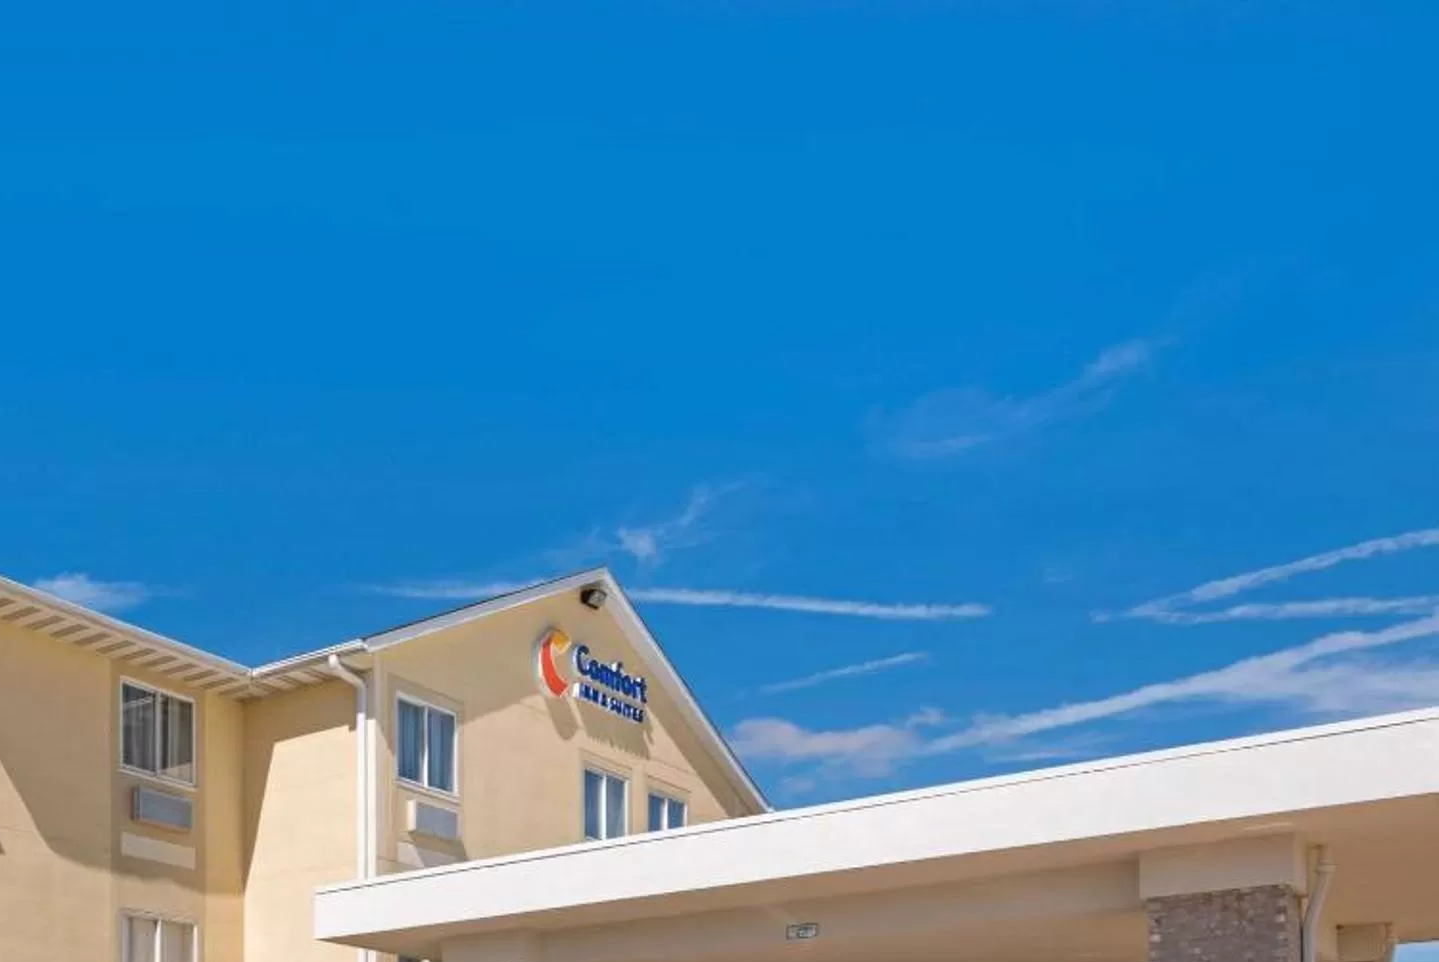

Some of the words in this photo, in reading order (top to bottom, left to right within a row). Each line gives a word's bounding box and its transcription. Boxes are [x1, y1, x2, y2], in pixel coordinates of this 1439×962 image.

[573, 643, 647, 704] Comfort
[573, 681, 600, 703] INN
[608, 697, 644, 723] SUITES
